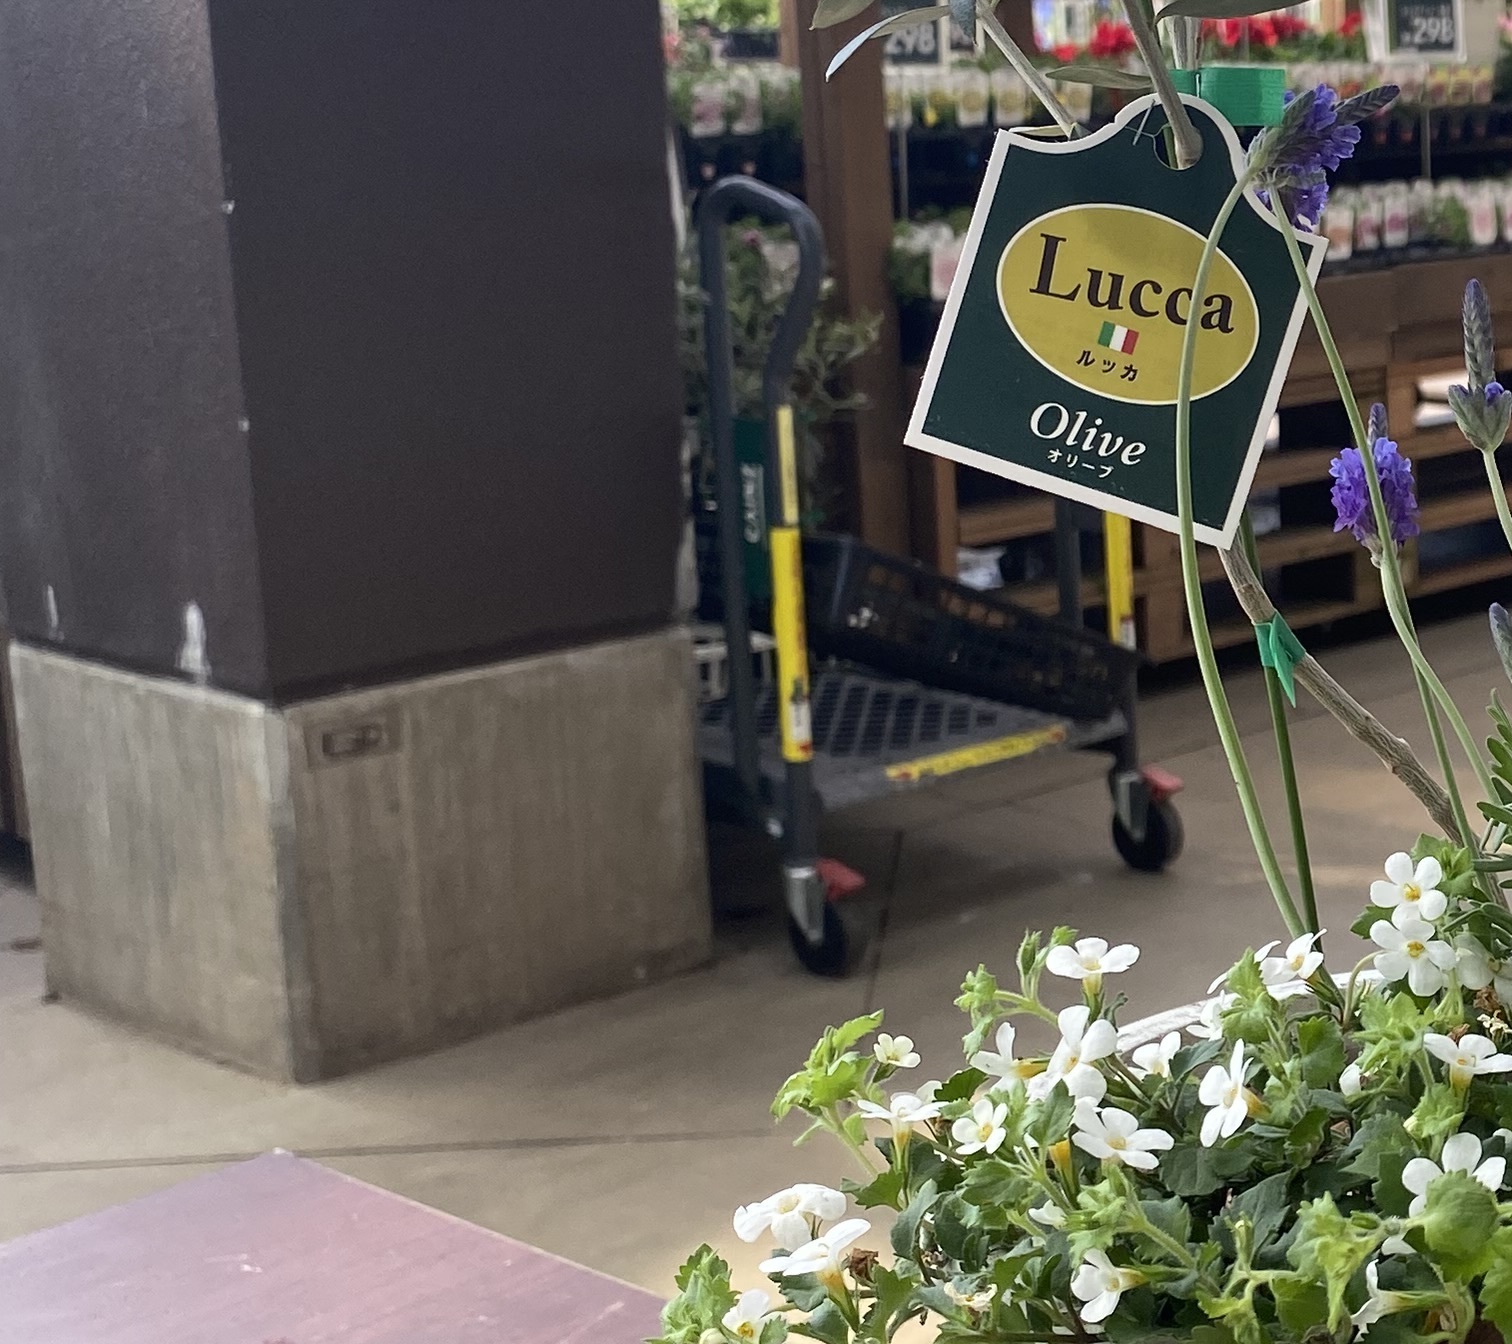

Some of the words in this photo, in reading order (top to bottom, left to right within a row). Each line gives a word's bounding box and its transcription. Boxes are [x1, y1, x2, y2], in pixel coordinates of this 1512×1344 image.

[1029, 233, 1235, 334] Lucca
[1076, 349, 1140, 383] ルッカ
[1029, 401, 1148, 466] Olive
[1047, 448, 1116, 479] オリーブ
